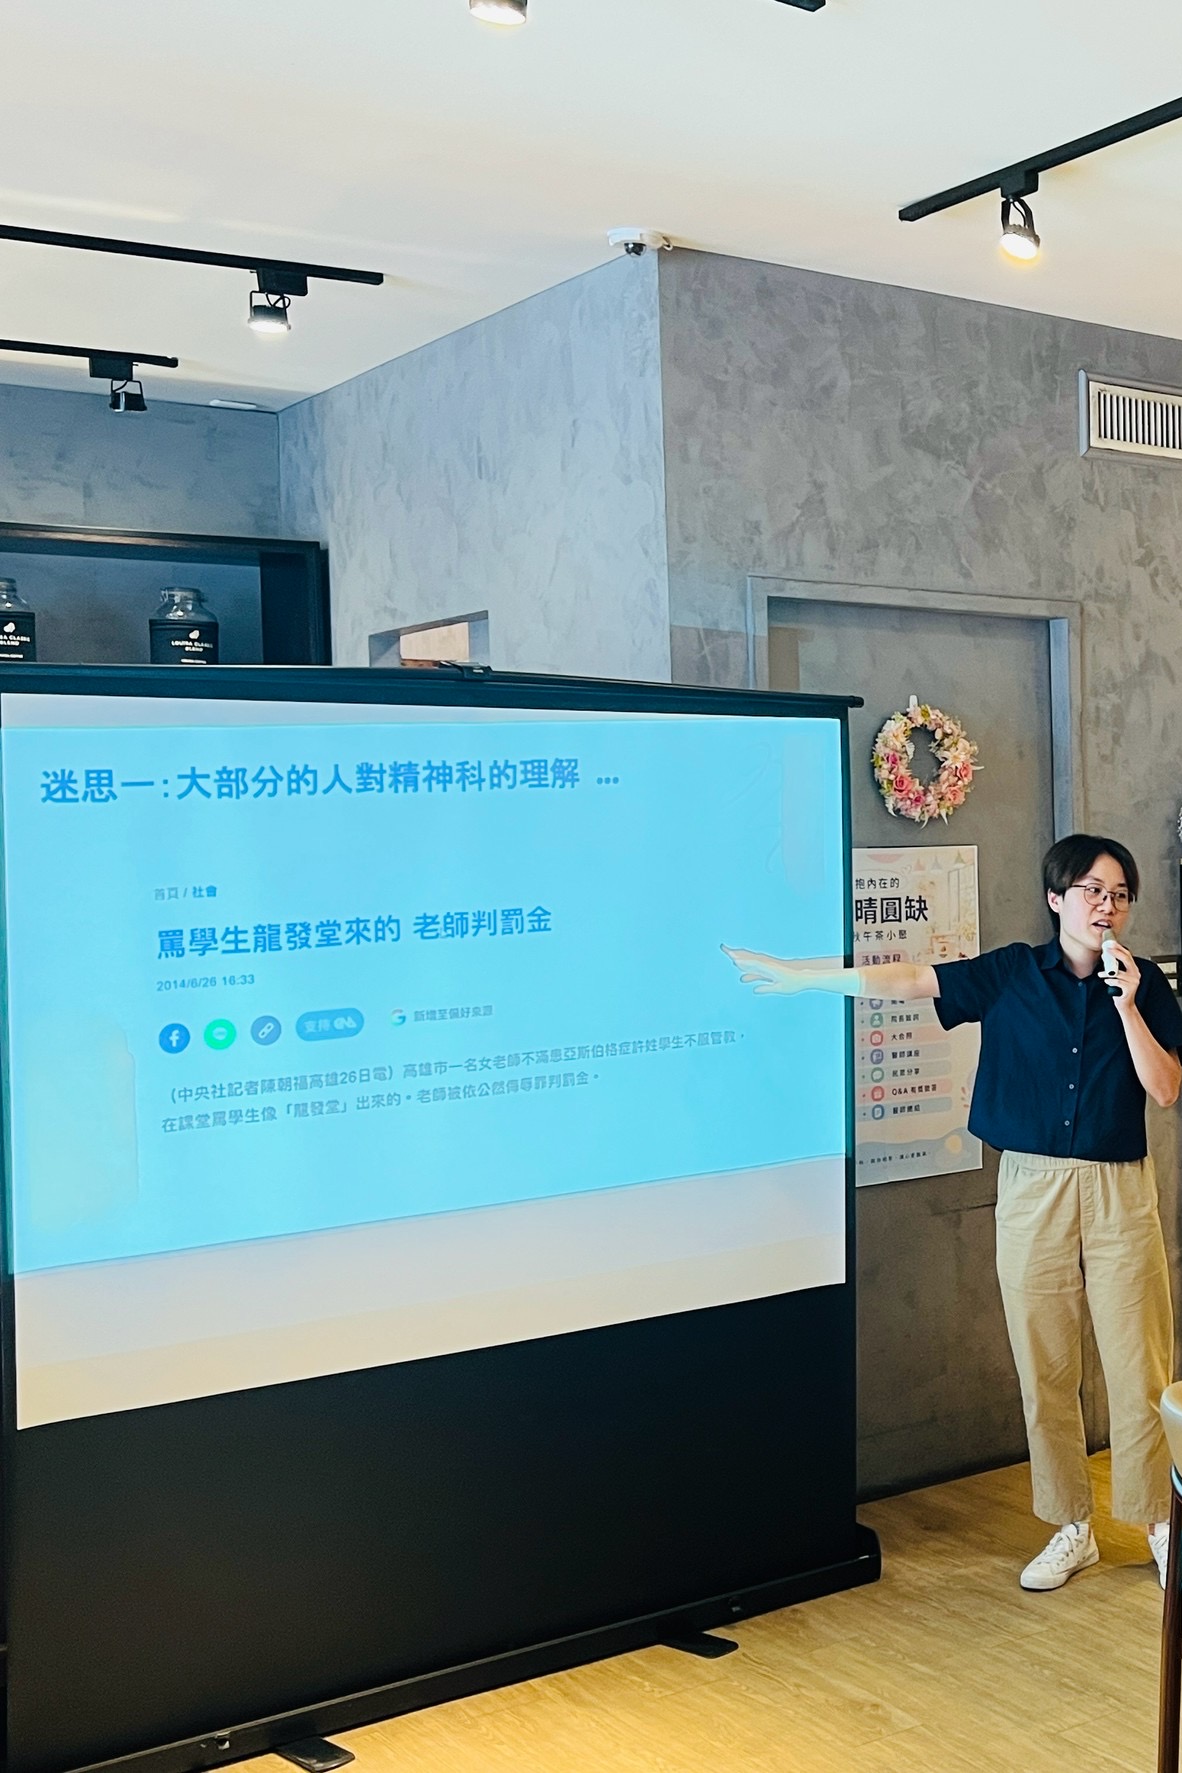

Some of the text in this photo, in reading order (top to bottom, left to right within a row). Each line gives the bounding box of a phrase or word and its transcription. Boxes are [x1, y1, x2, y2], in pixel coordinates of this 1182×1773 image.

[192, 885, 217, 898] 社會
[855, 895, 929, 925] 晴圓缺
[157, 905, 552, 960] 罵學生龍發堂來的 老師判罰金
[222, 973, 255, 986] 16:33
[891, 1087, 909, 1096] Q&A
